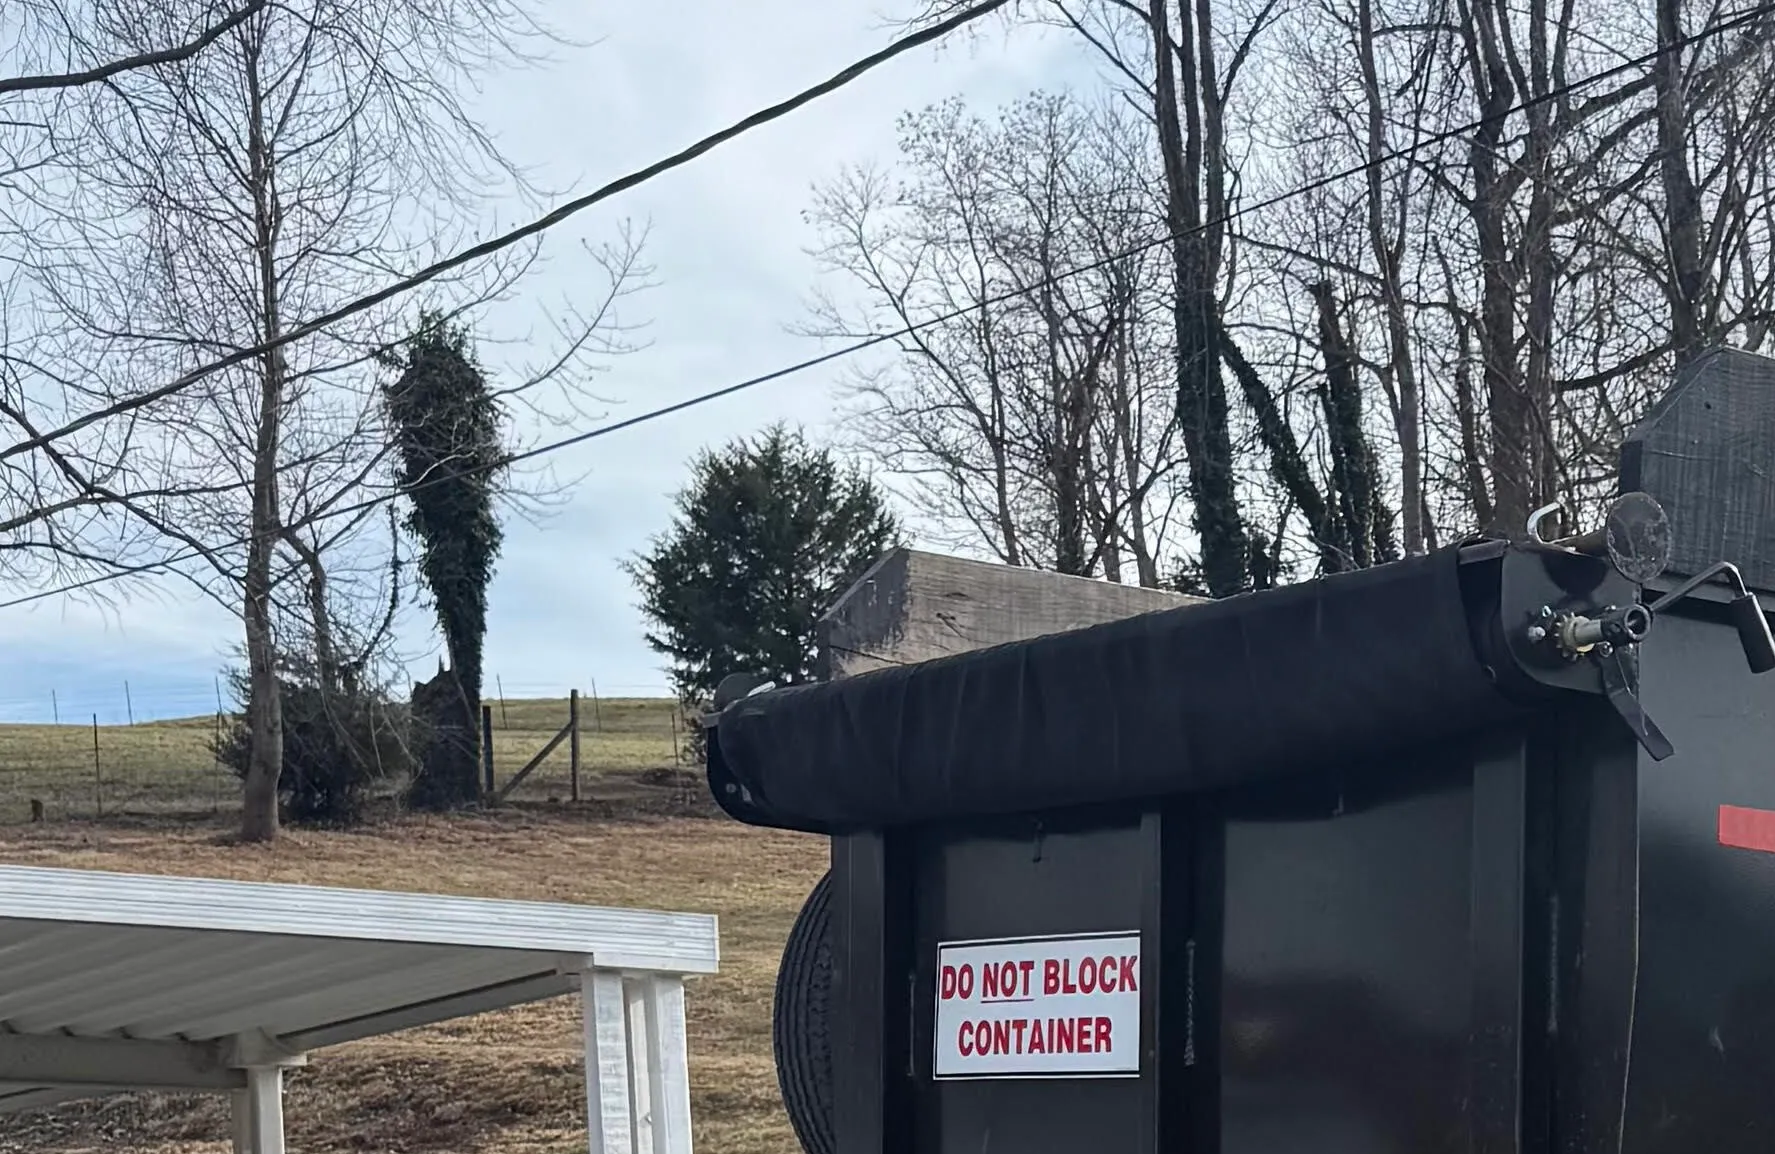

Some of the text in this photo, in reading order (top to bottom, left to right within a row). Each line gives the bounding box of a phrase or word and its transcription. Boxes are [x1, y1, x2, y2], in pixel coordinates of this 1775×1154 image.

[941, 955, 1138, 1000] DO NOT BLOCK
[958, 1016, 1113, 1057] CONTAINER
